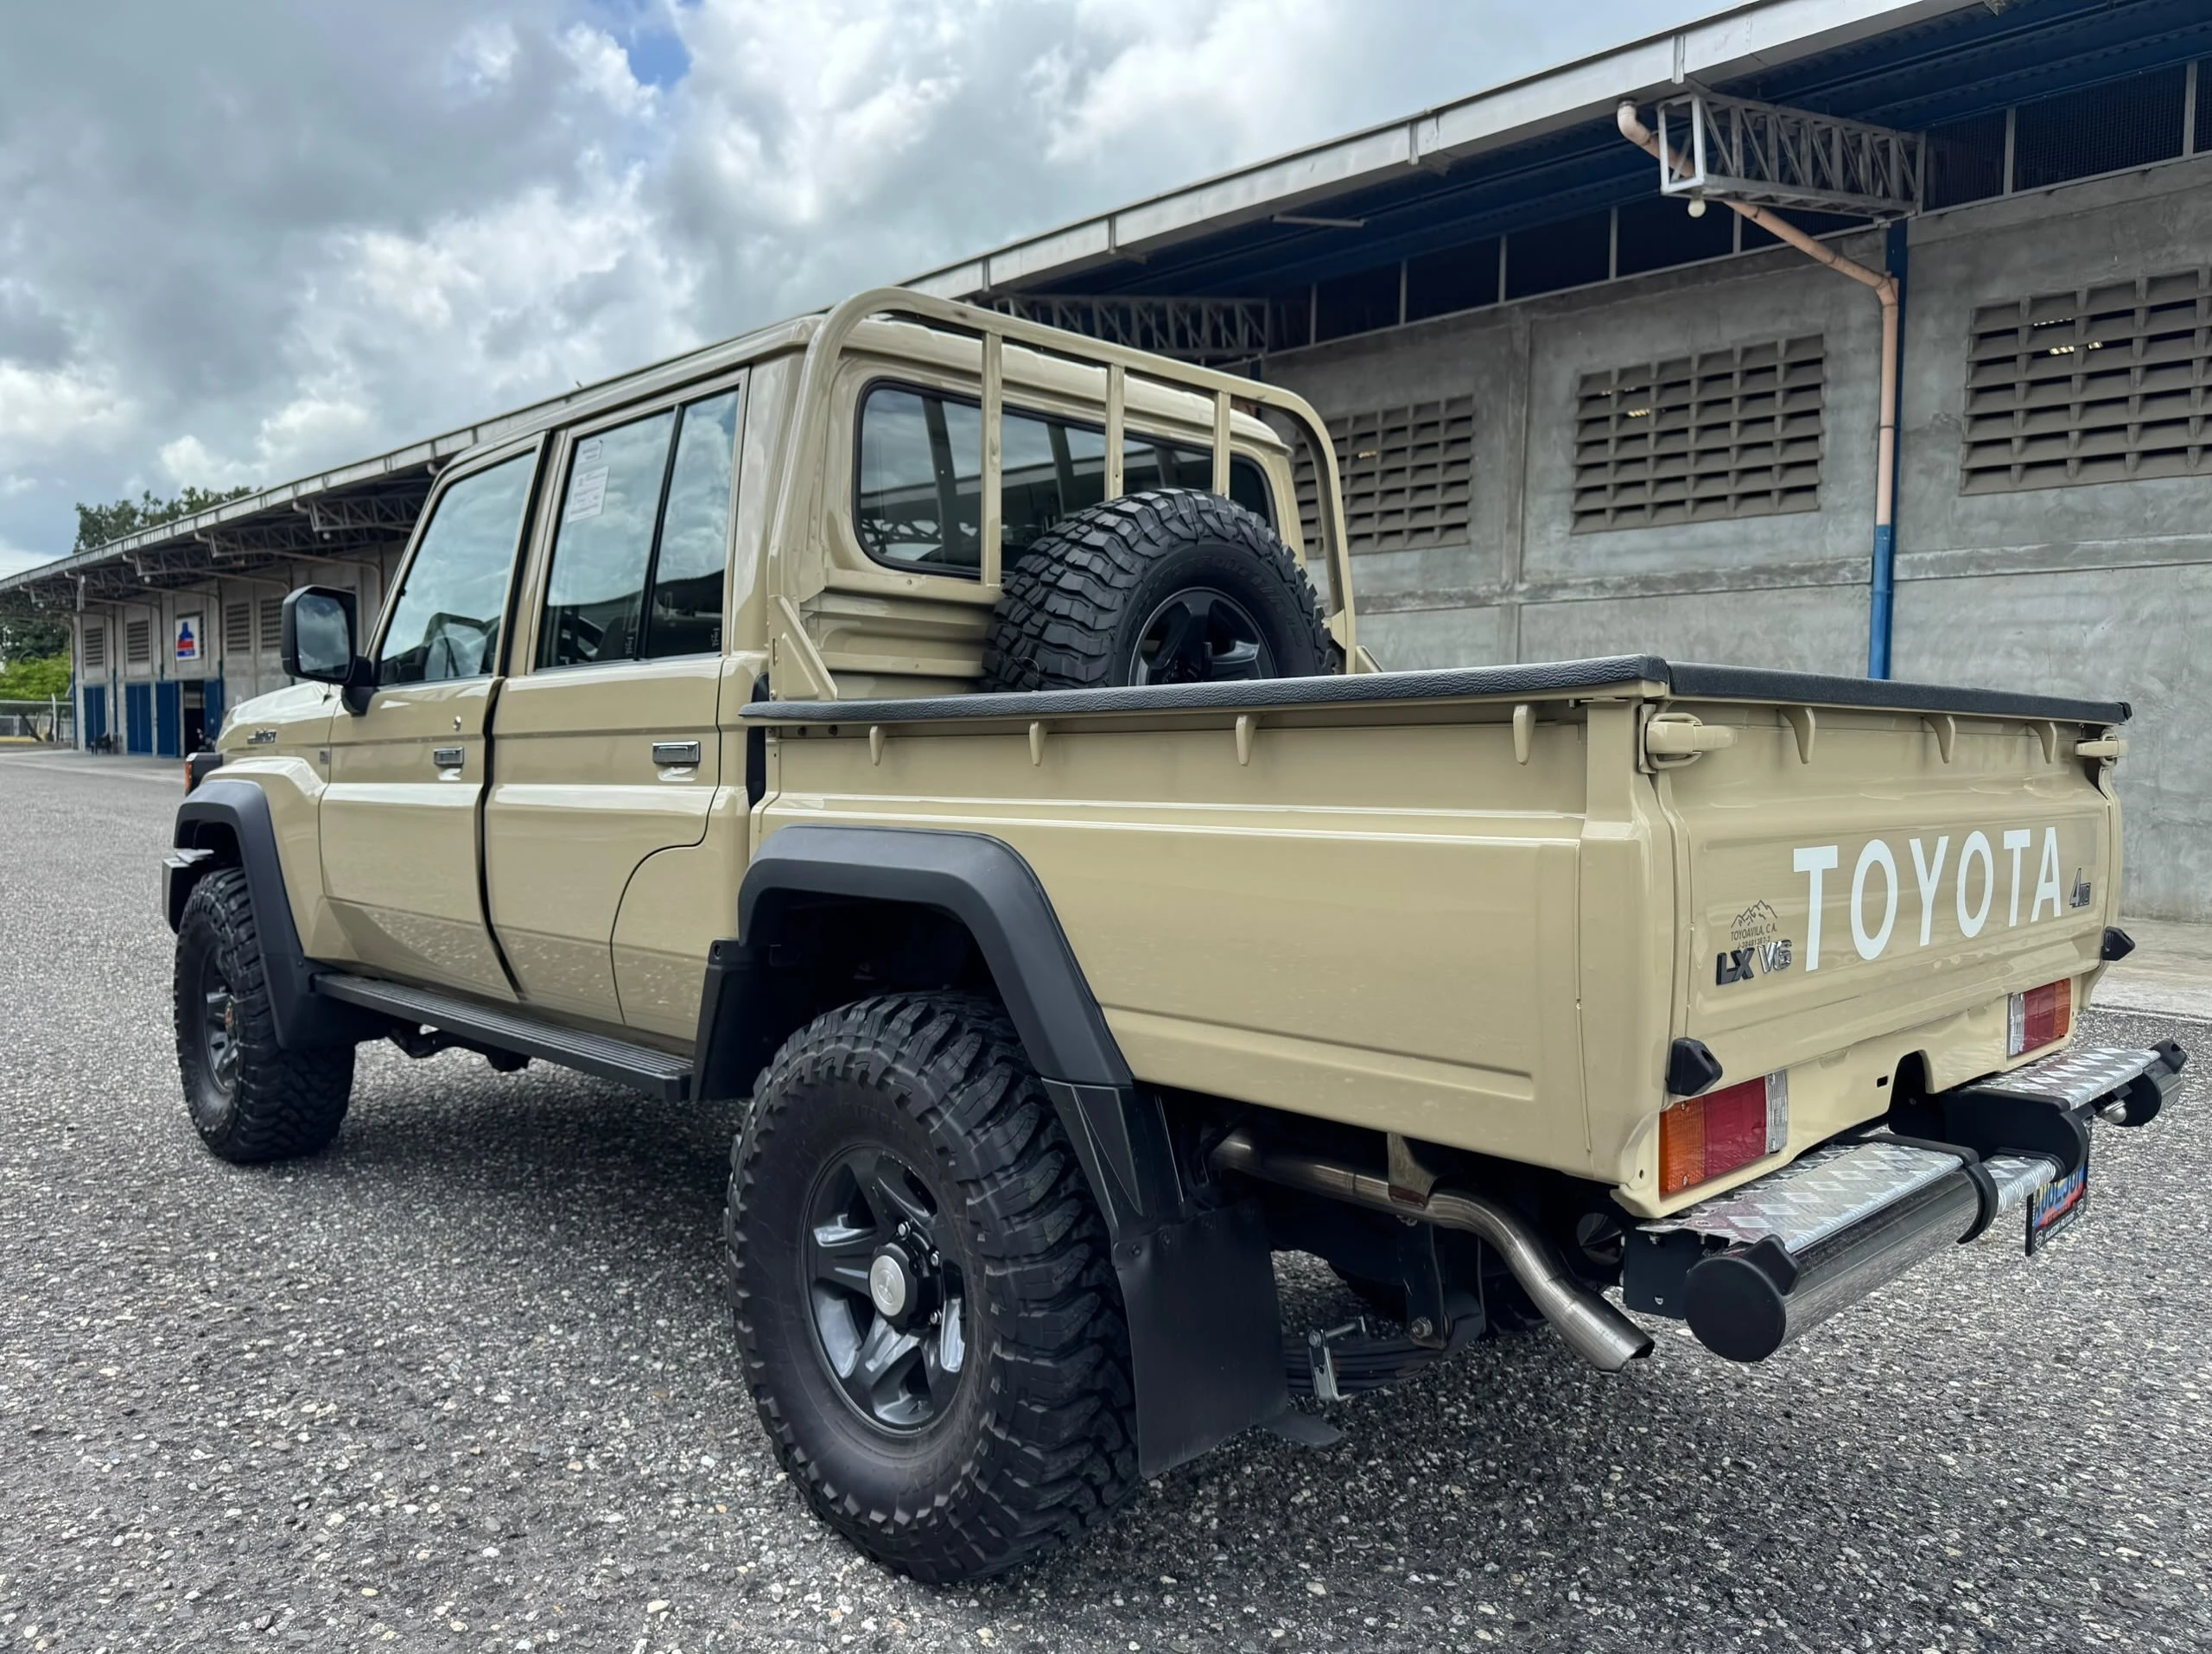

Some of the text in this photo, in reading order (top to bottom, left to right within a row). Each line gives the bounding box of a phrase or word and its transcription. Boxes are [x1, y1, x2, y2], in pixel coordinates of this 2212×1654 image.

[1794, 827, 2062, 971] TOYOTA
[1716, 939, 1792, 985] LX V6
